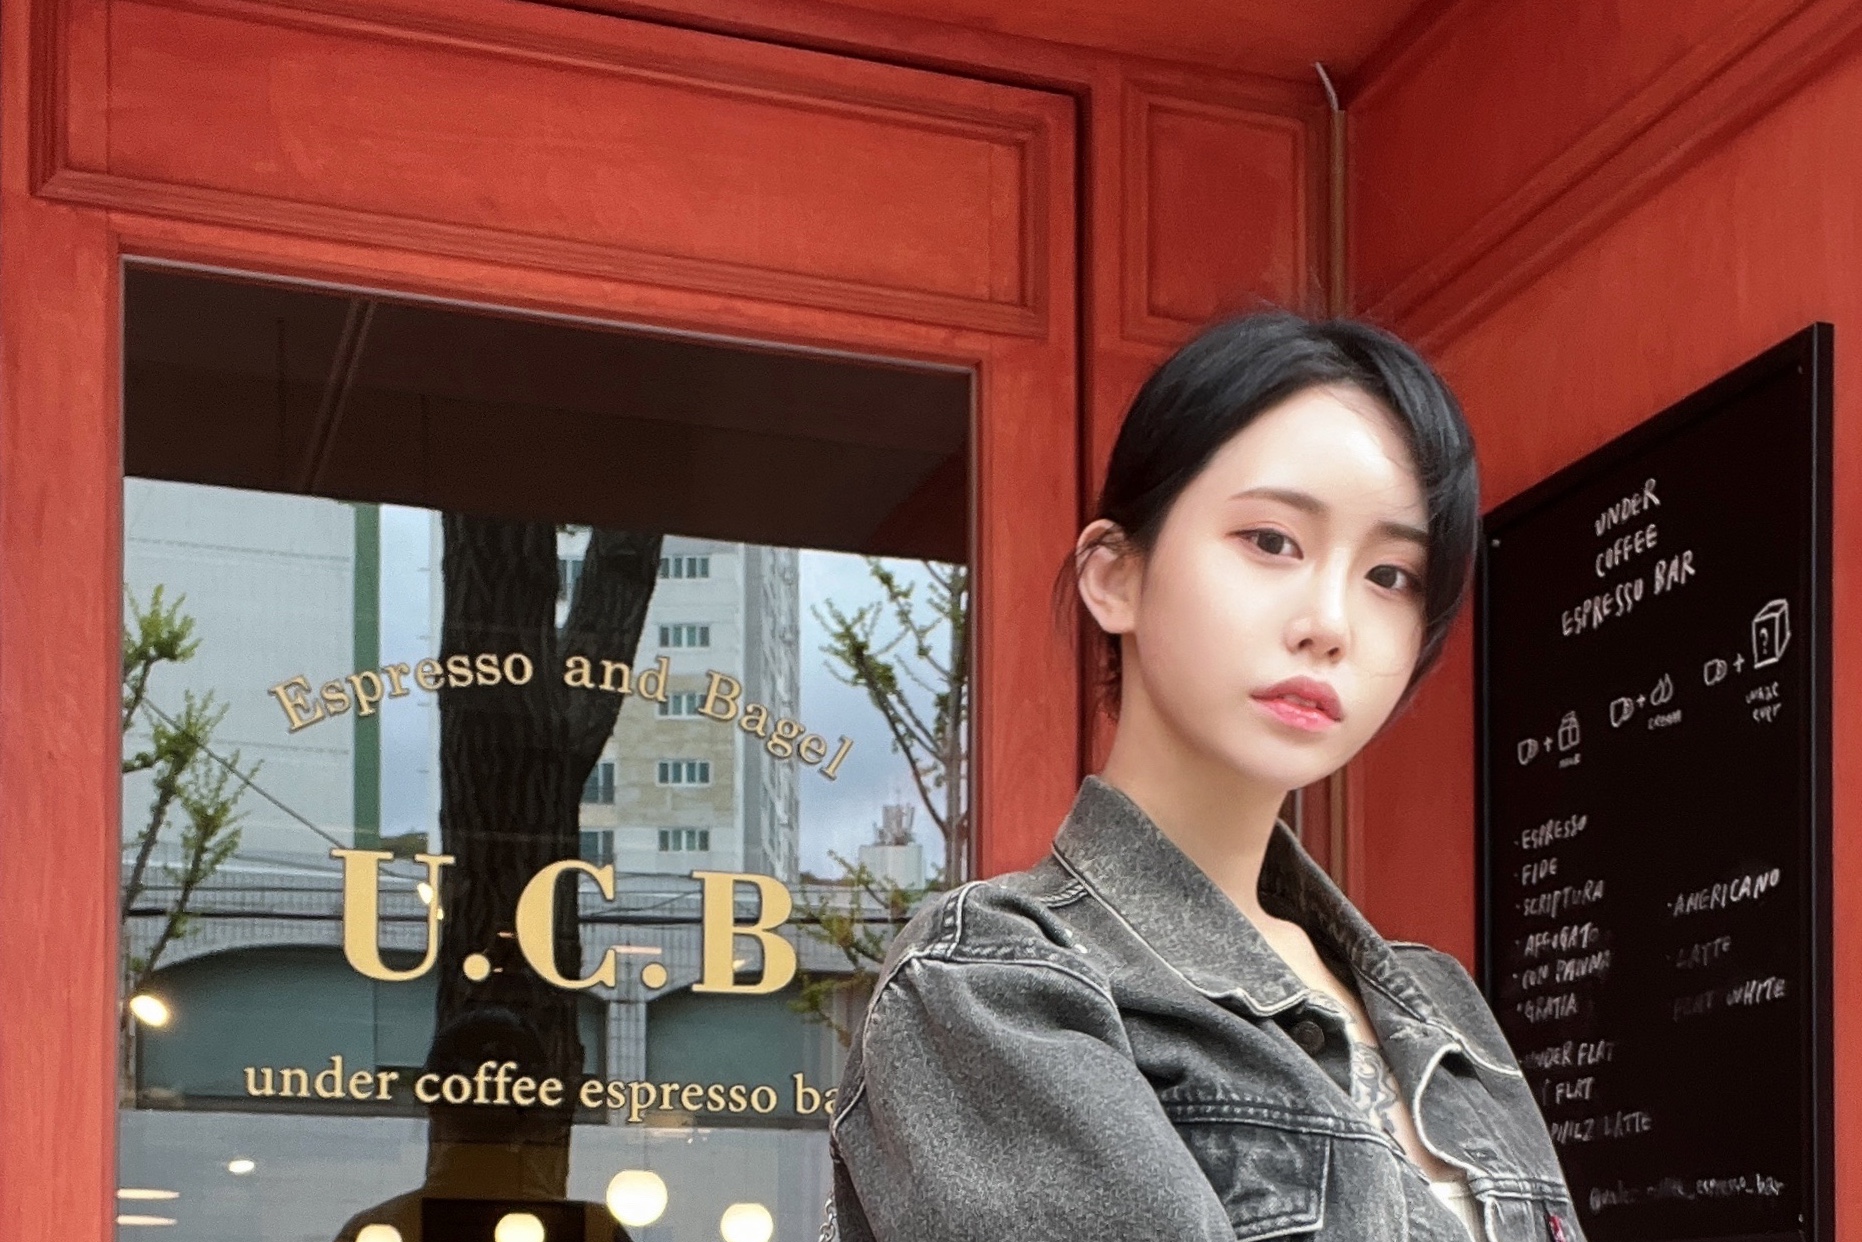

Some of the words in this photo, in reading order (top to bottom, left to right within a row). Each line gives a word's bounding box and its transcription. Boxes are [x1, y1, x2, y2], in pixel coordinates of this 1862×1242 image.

[1595, 524, 1658, 578] COFFEE
[1561, 579, 1644, 637] ESPRESSO
[1654, 550, 1697, 596] BAR
[269, 652, 532, 733] Espresso
[564, 654, 669, 704] and
[699, 671, 855, 781] Bagel
[1521, 814, 1588, 849] ESPRESSO
[1521, 857, 1558, 886] FIDE
[1672, 867, 1781, 917] AMERICANO
[330, 848, 798, 995] U.C.B
[244, 1057, 398, 1100] under
[415, 1061, 563, 1107] coffee
[580, 1080, 777, 1122] espresso
[795, 1074, 839, 1114] ba
